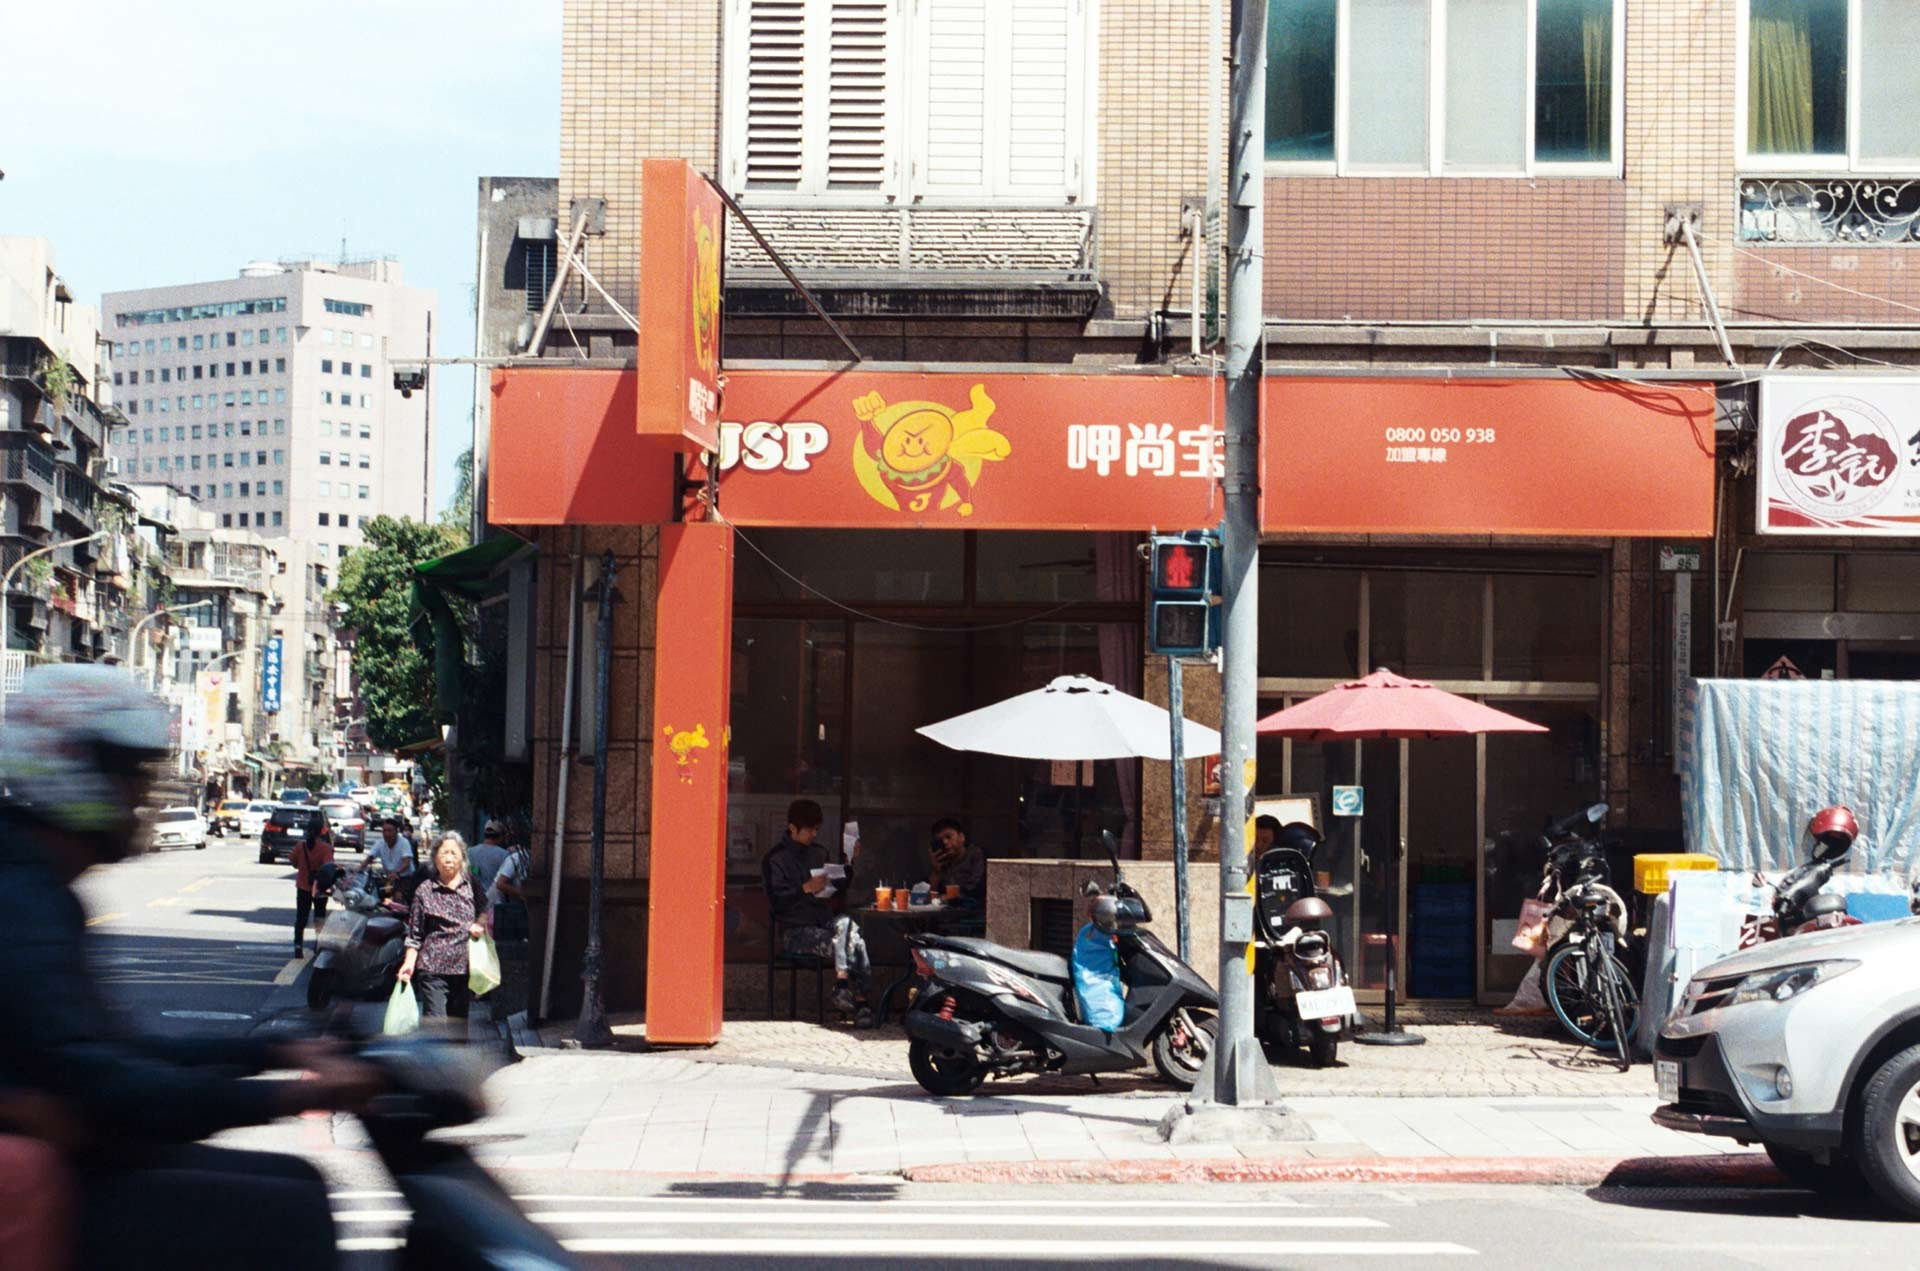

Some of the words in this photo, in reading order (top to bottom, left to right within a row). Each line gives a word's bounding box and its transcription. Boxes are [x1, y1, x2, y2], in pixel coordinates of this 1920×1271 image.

[700, 421, 829, 470] JSP
[1386, 427, 1426, 442] 0800
[1430, 428, 1461, 443] 050
[1465, 428, 1496, 444] 938
[1782, 410, 1888, 484] 李記
